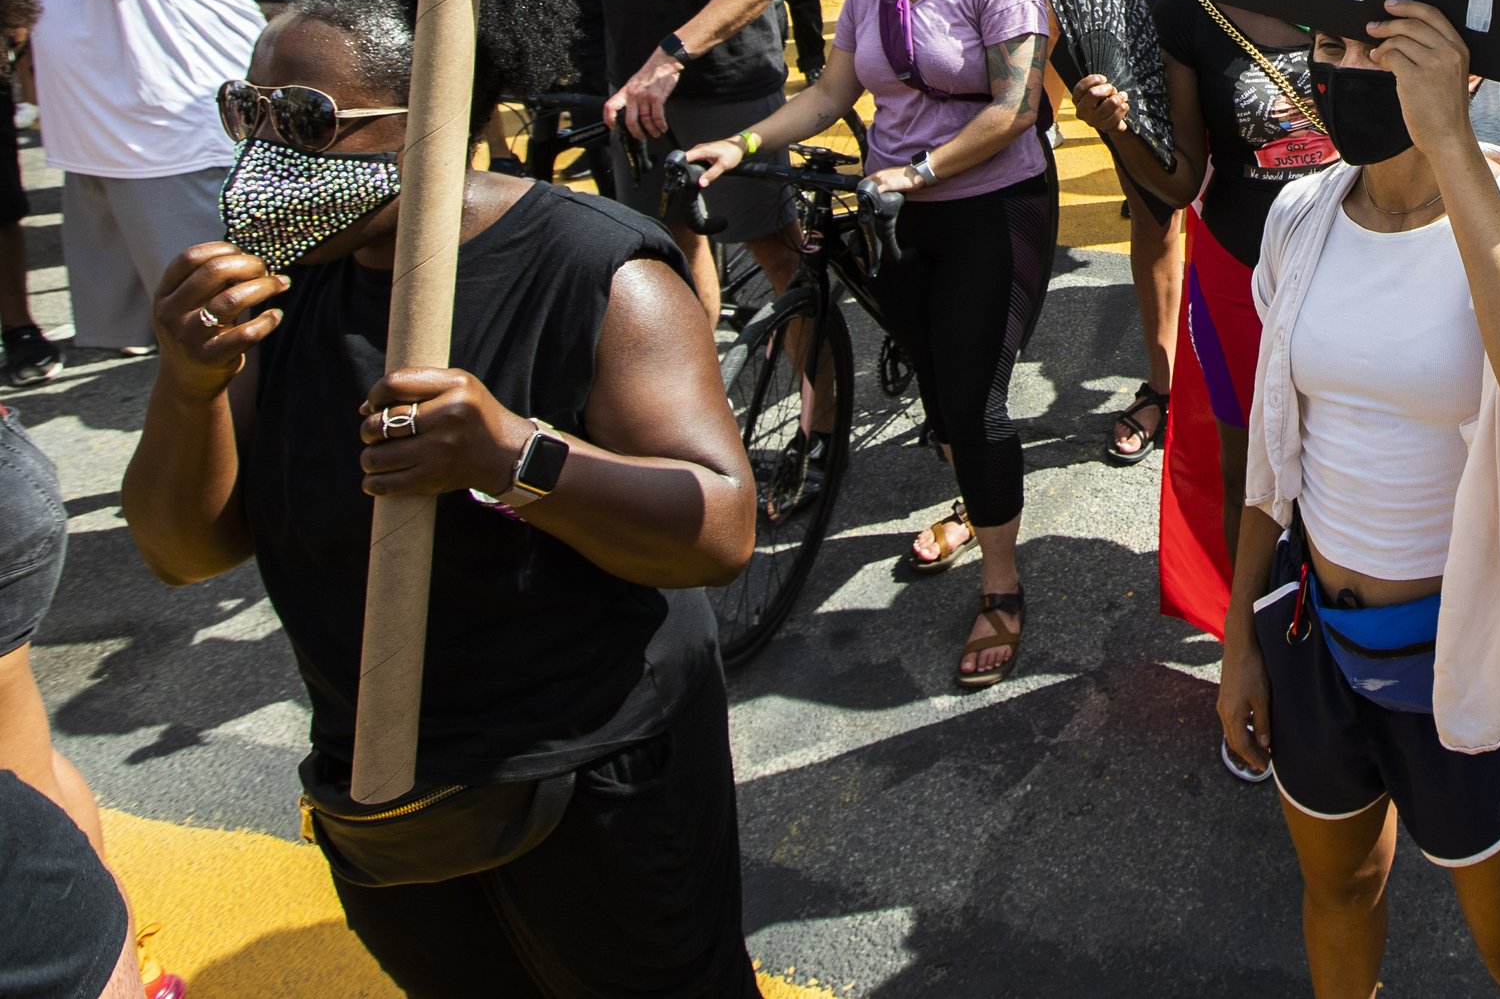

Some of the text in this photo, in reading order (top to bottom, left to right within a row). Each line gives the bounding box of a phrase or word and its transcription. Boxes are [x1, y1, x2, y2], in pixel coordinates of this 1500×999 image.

[1286, 142, 1308, 152] GOT
[1274, 151, 1323, 167] JUSTICE?
[1262, 171, 1284, 180] should
